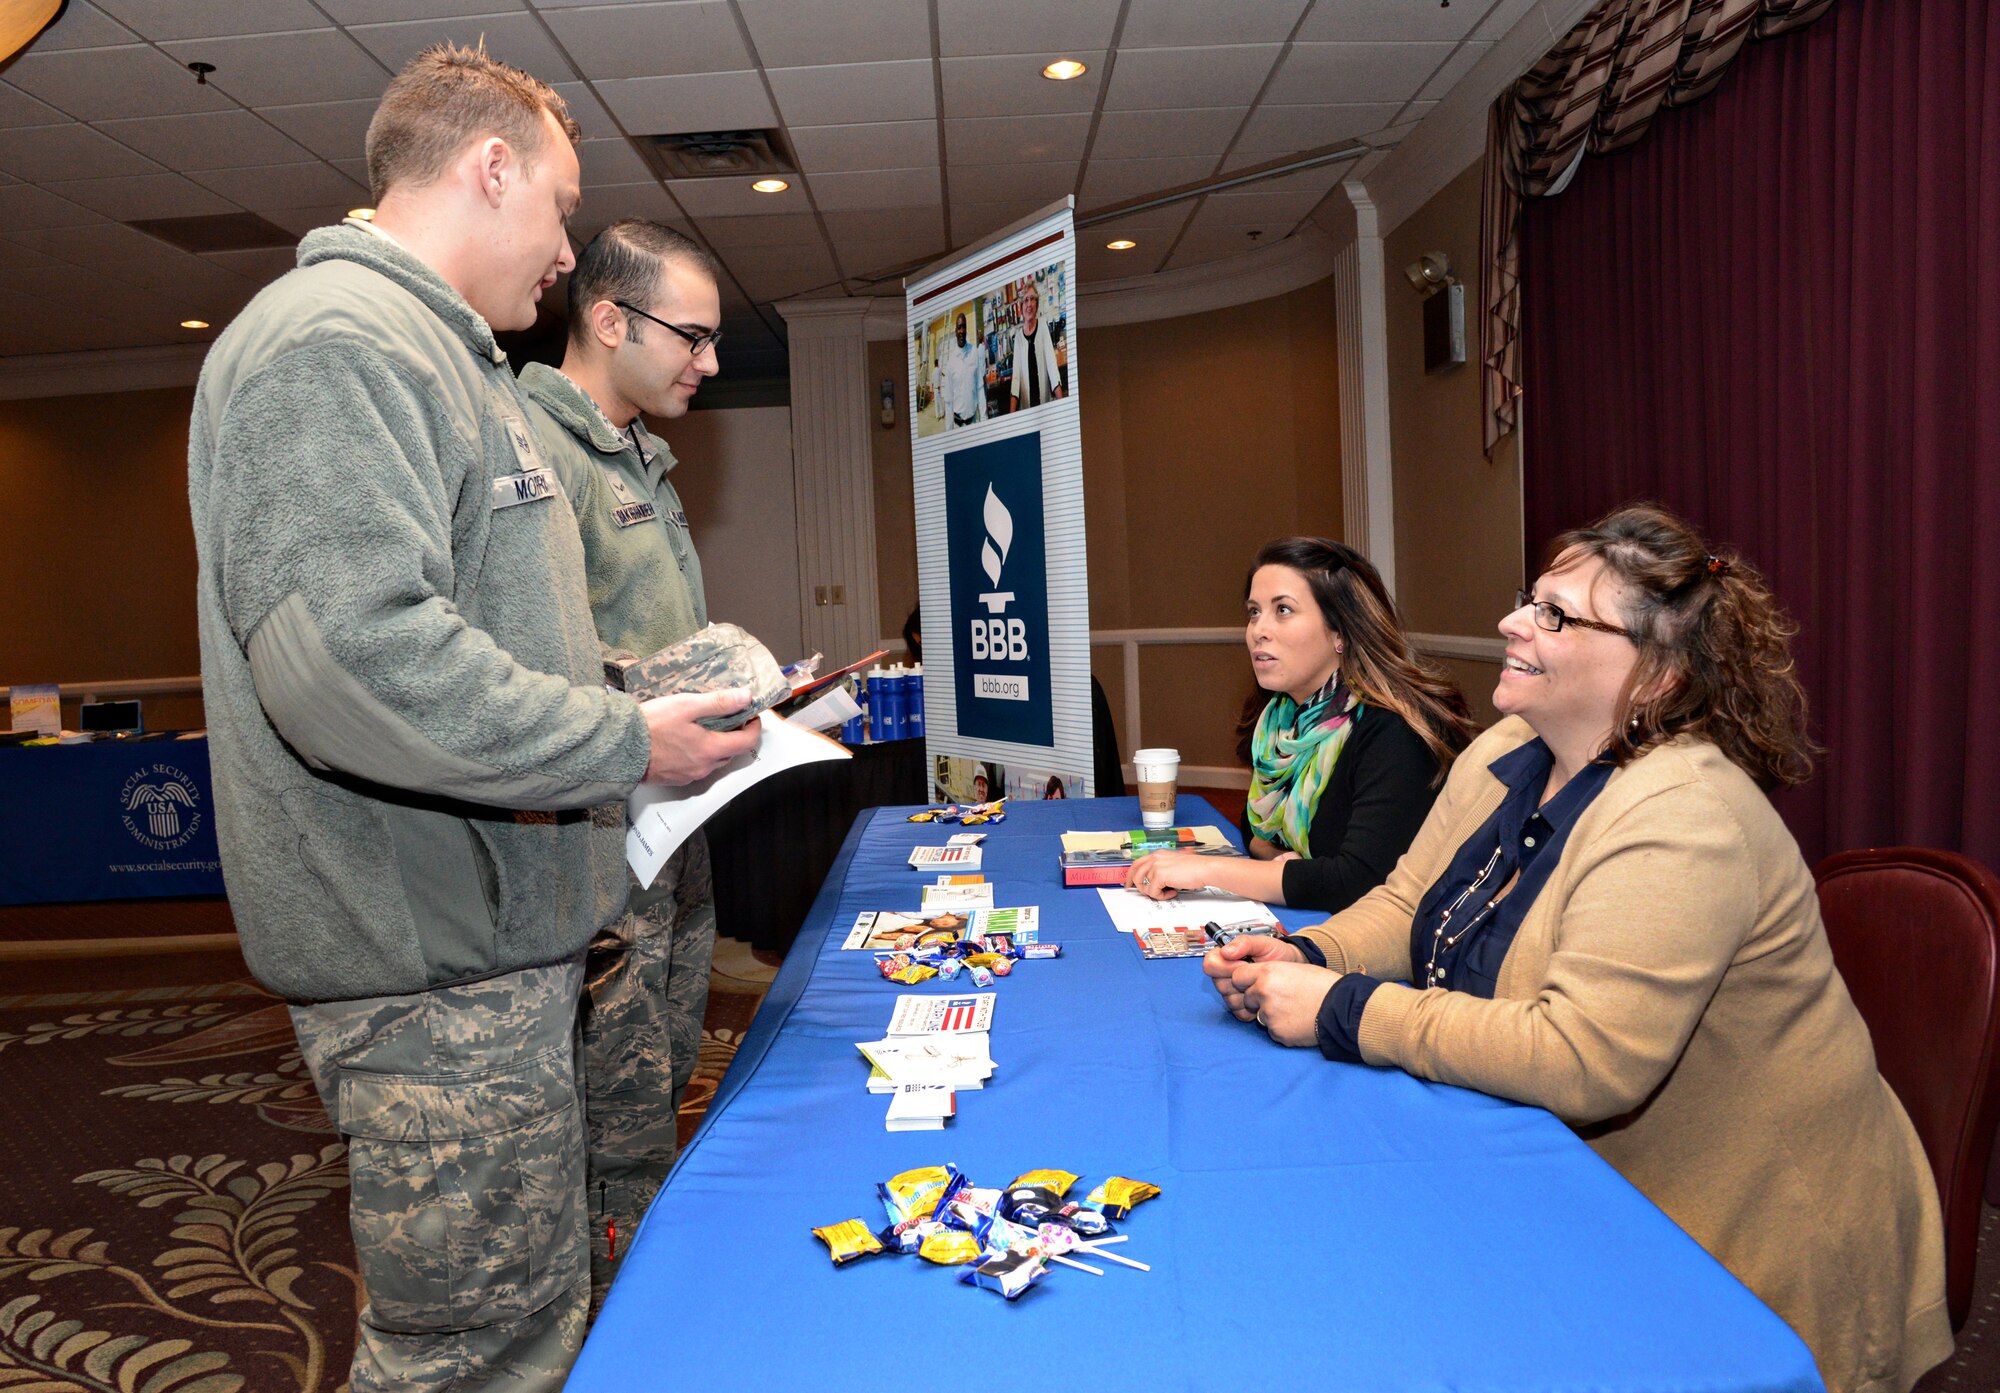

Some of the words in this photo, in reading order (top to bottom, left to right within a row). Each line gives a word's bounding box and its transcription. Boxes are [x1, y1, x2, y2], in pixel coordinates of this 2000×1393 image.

[970, 618, 1028, 661] BBB
[982, 677, 1020, 698] bbb.org
[120, 767, 149, 804] SOCIAL
[153, 763, 201, 801] SECURITY
[147, 802, 177, 814] USA
[122, 811, 202, 851] ADMINISTRATION
[109, 859, 222, 873] www.socialsecurity.go
